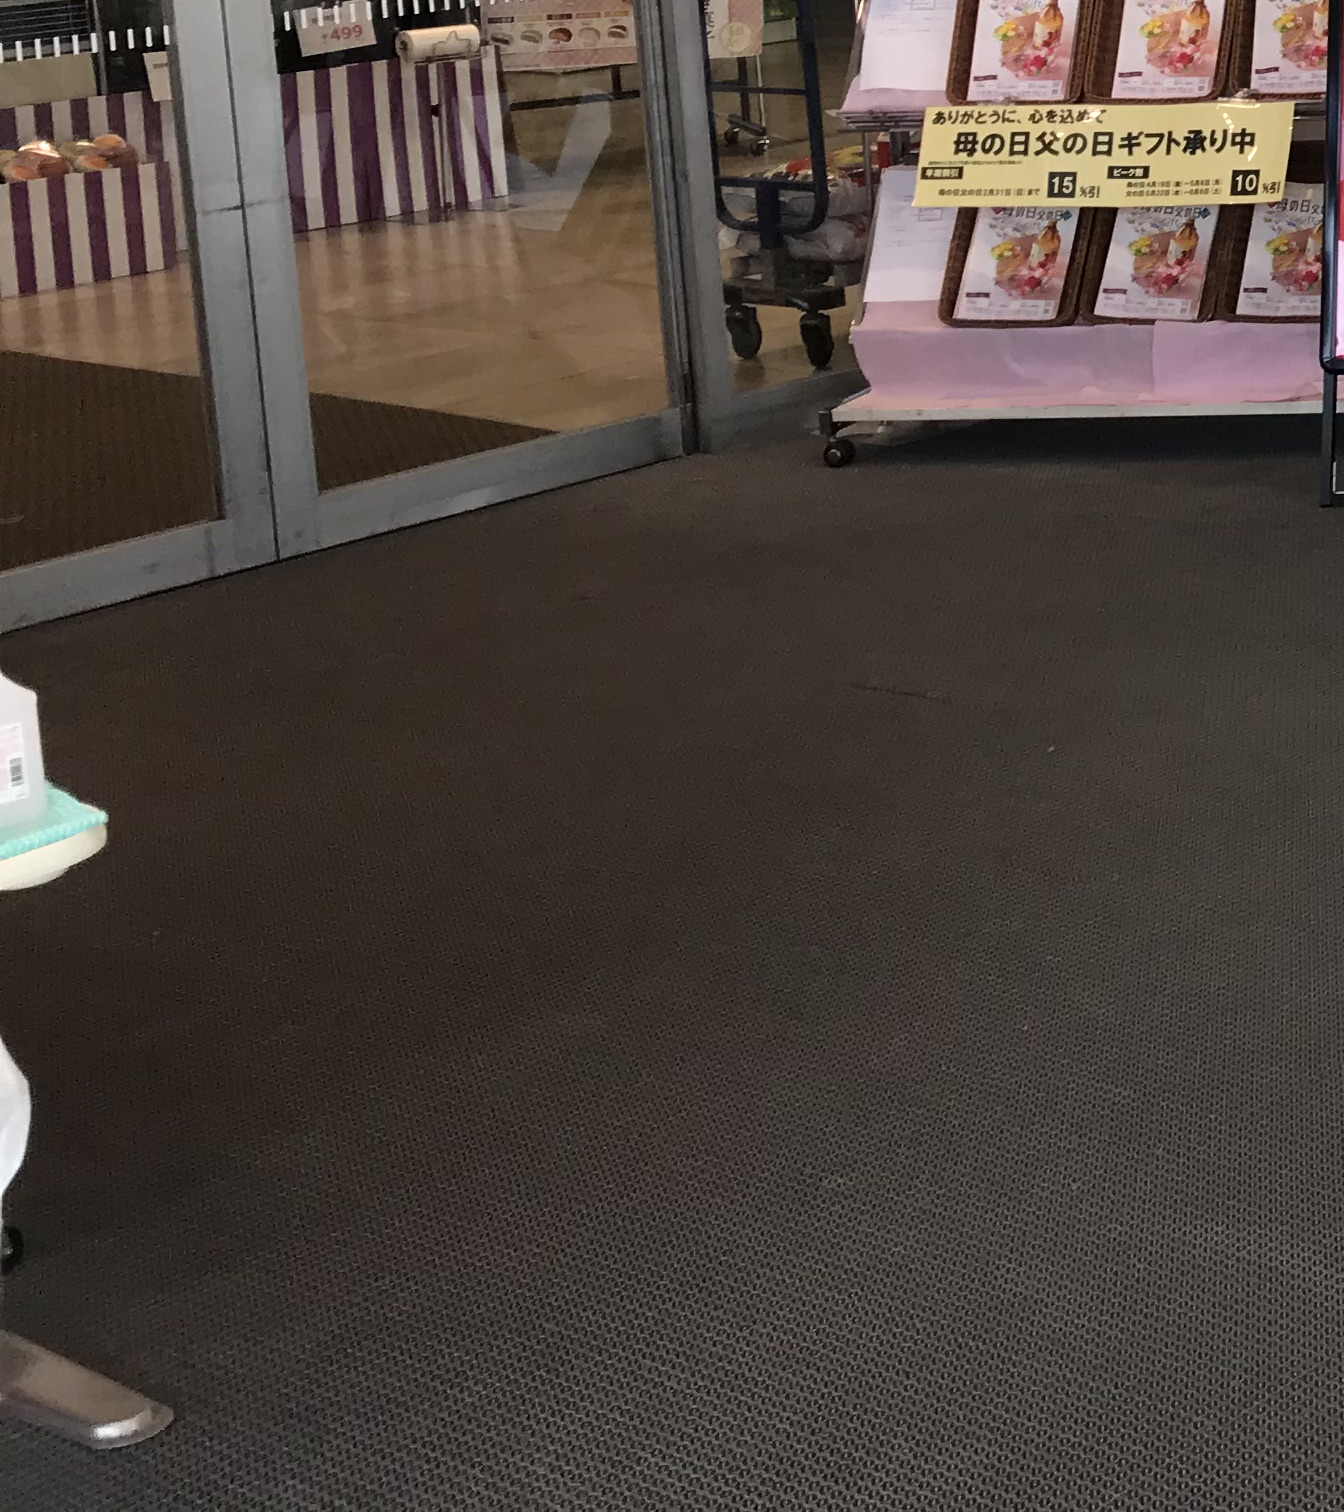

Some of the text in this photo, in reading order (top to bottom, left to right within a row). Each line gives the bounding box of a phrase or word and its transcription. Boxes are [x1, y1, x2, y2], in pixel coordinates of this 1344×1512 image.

[953, 129, 1256, 158] 母の日父の日ギフト承り中
[1051, 176, 1073, 195] 15
[1234, 174, 1257, 192] 10
